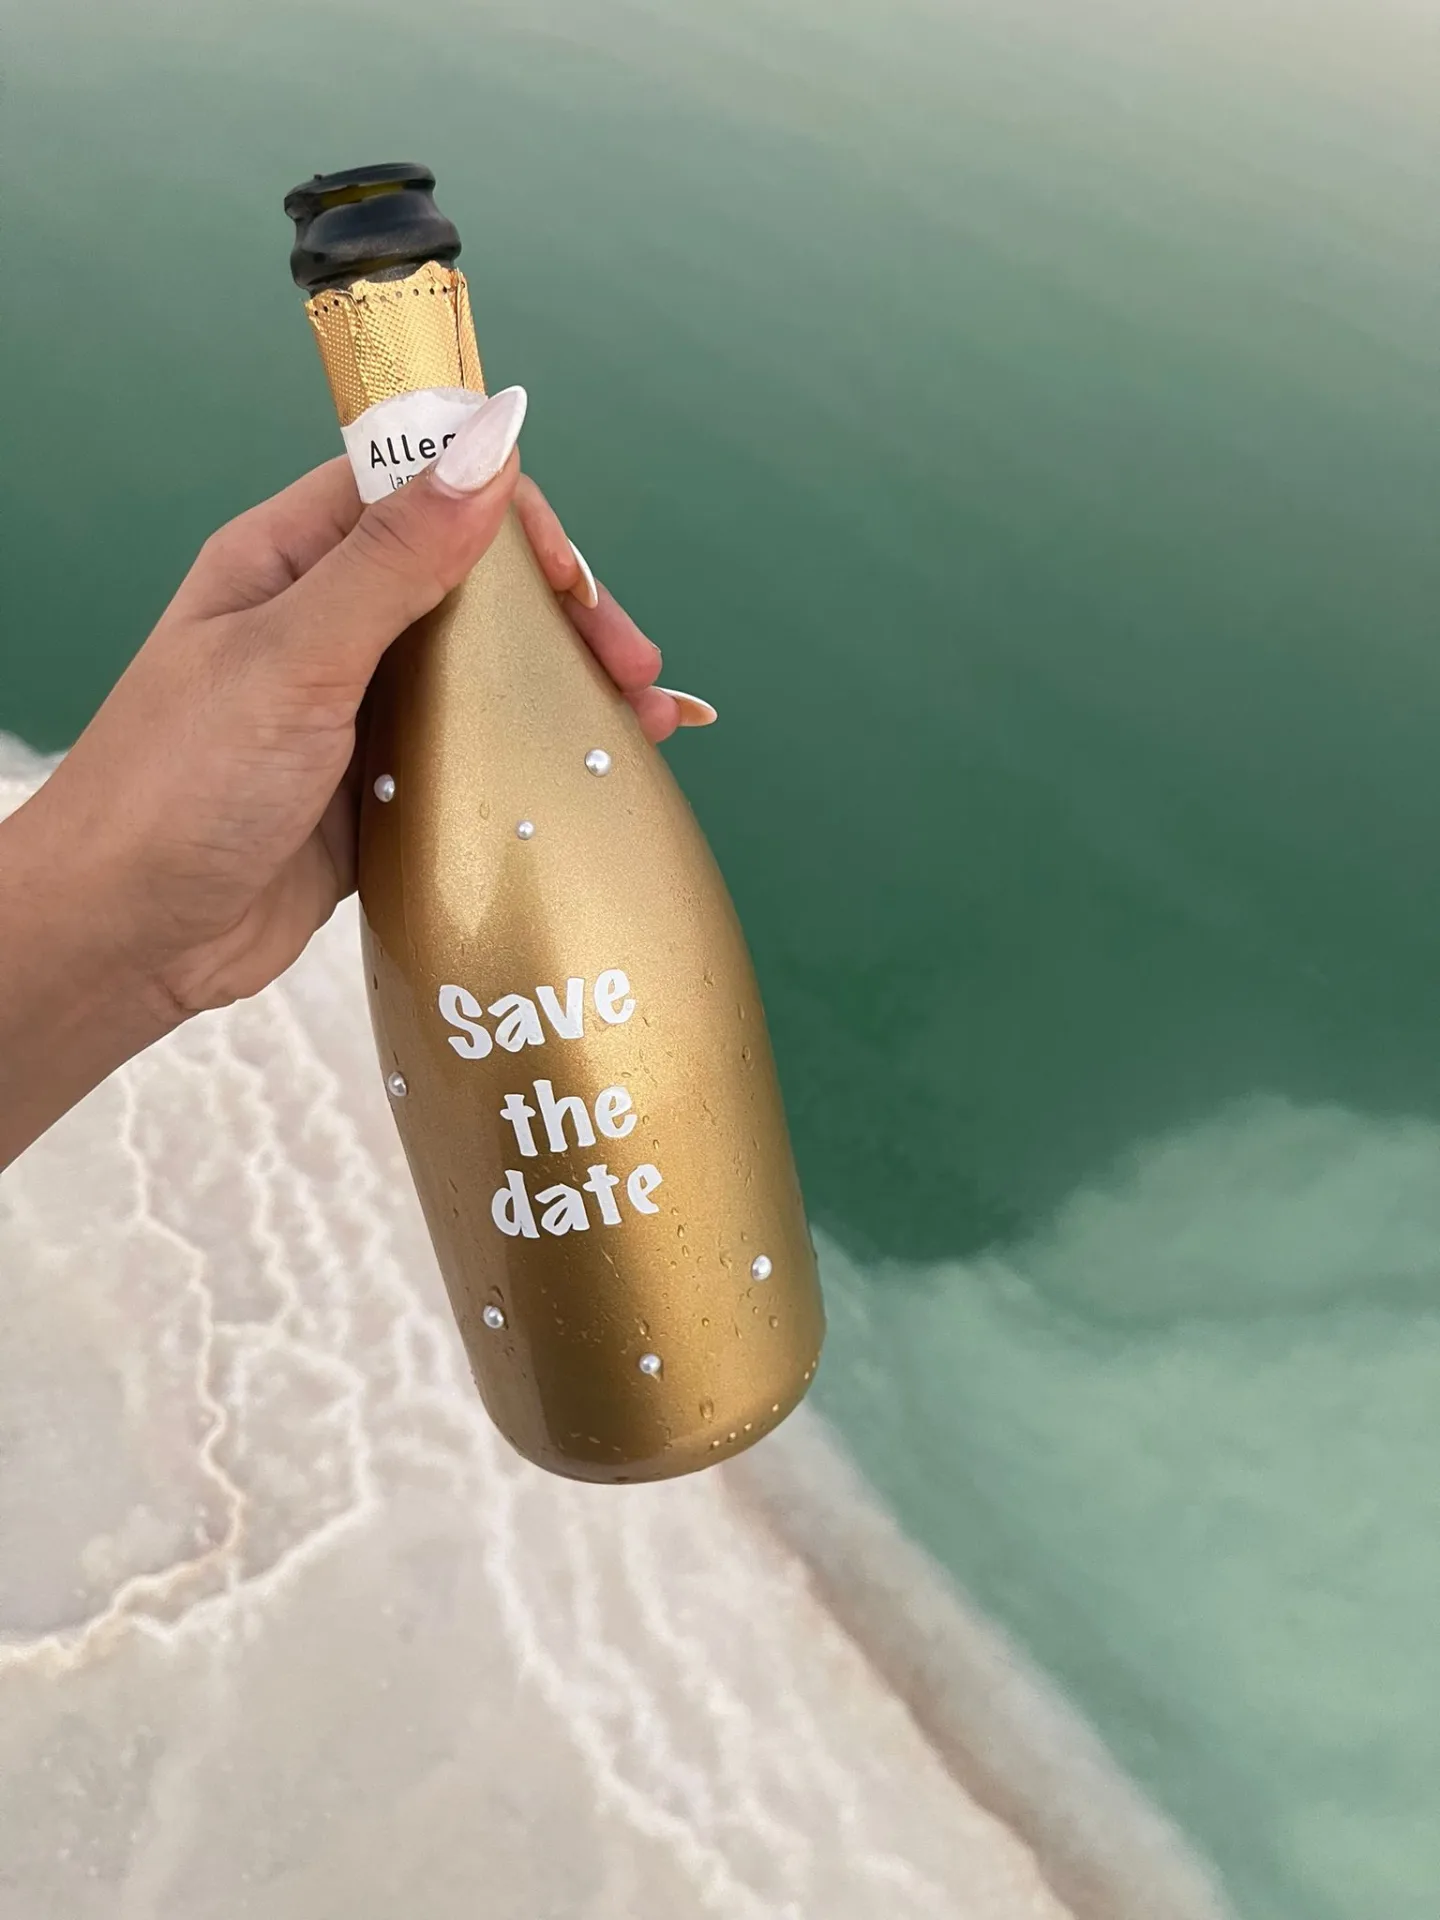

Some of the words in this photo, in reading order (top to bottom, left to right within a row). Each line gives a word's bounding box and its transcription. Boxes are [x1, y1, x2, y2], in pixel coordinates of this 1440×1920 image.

[438, 968, 637, 1060] Save
[499, 1079, 638, 1157] the
[491, 1163, 664, 1239] date
